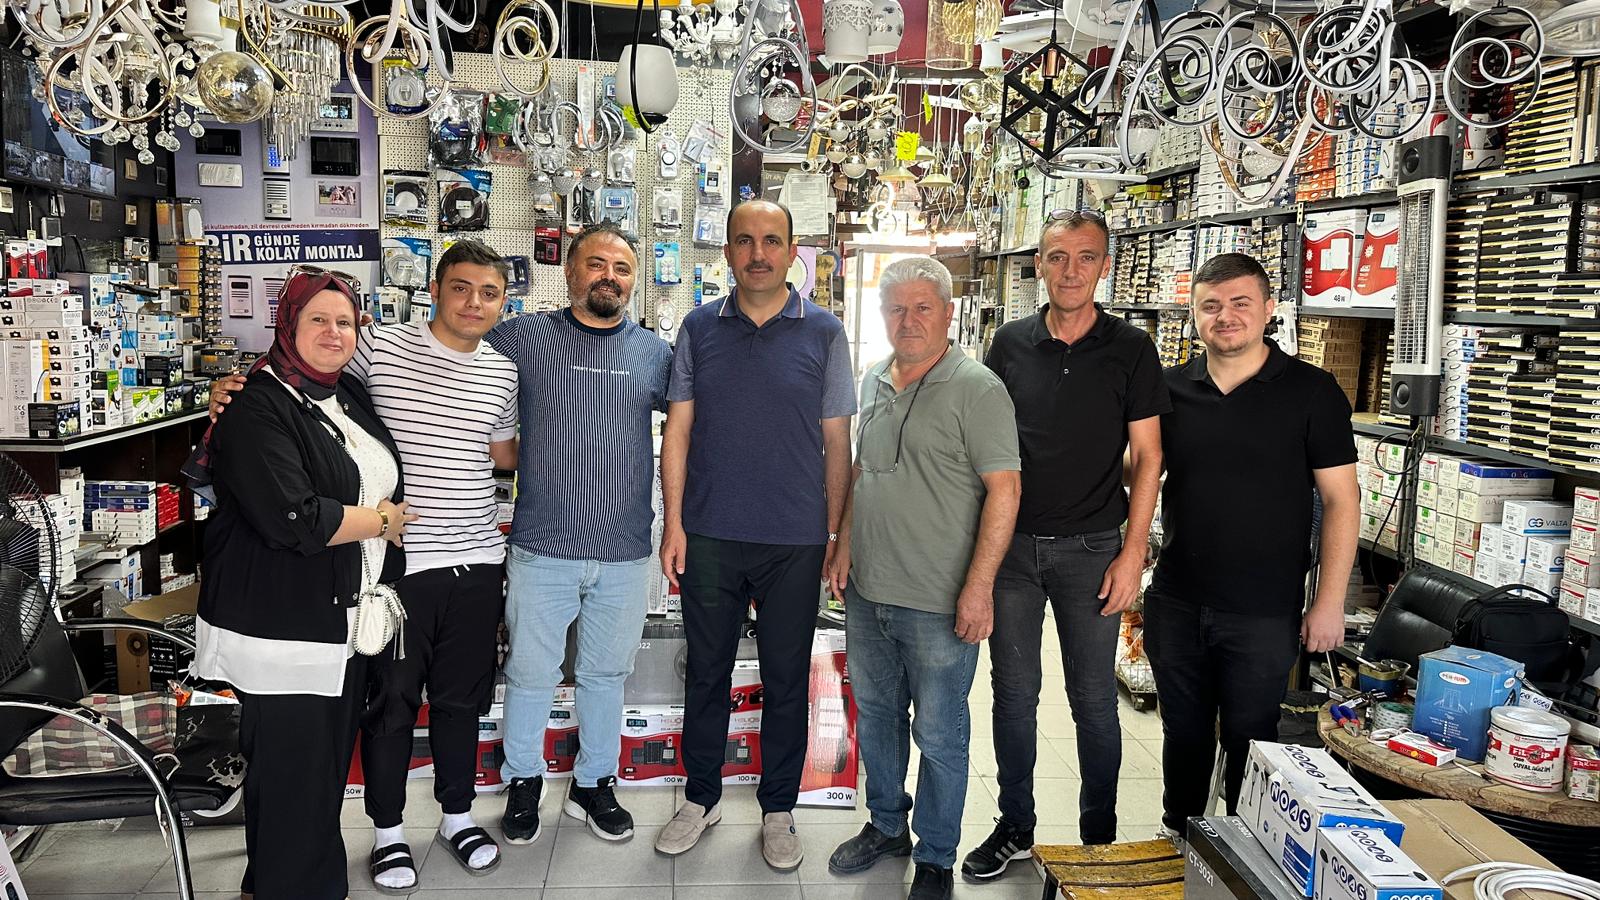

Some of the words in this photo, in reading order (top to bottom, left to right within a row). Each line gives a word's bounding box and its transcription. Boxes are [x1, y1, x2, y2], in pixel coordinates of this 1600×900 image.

[254, 233, 300, 247] GÜNDE
[256, 246, 301, 261] KOLAY
[305, 244, 363, 261] MONTAJ
[1546, 519, 1568, 527] VALTA
[826, 791, 844, 800] 300
[1270, 781, 1312, 833] NOAS
[1350, 830, 1394, 863] NOAS
[1188, 851, 1214, 887] CT-3021
[1331, 856, 1367, 900] NOAS
